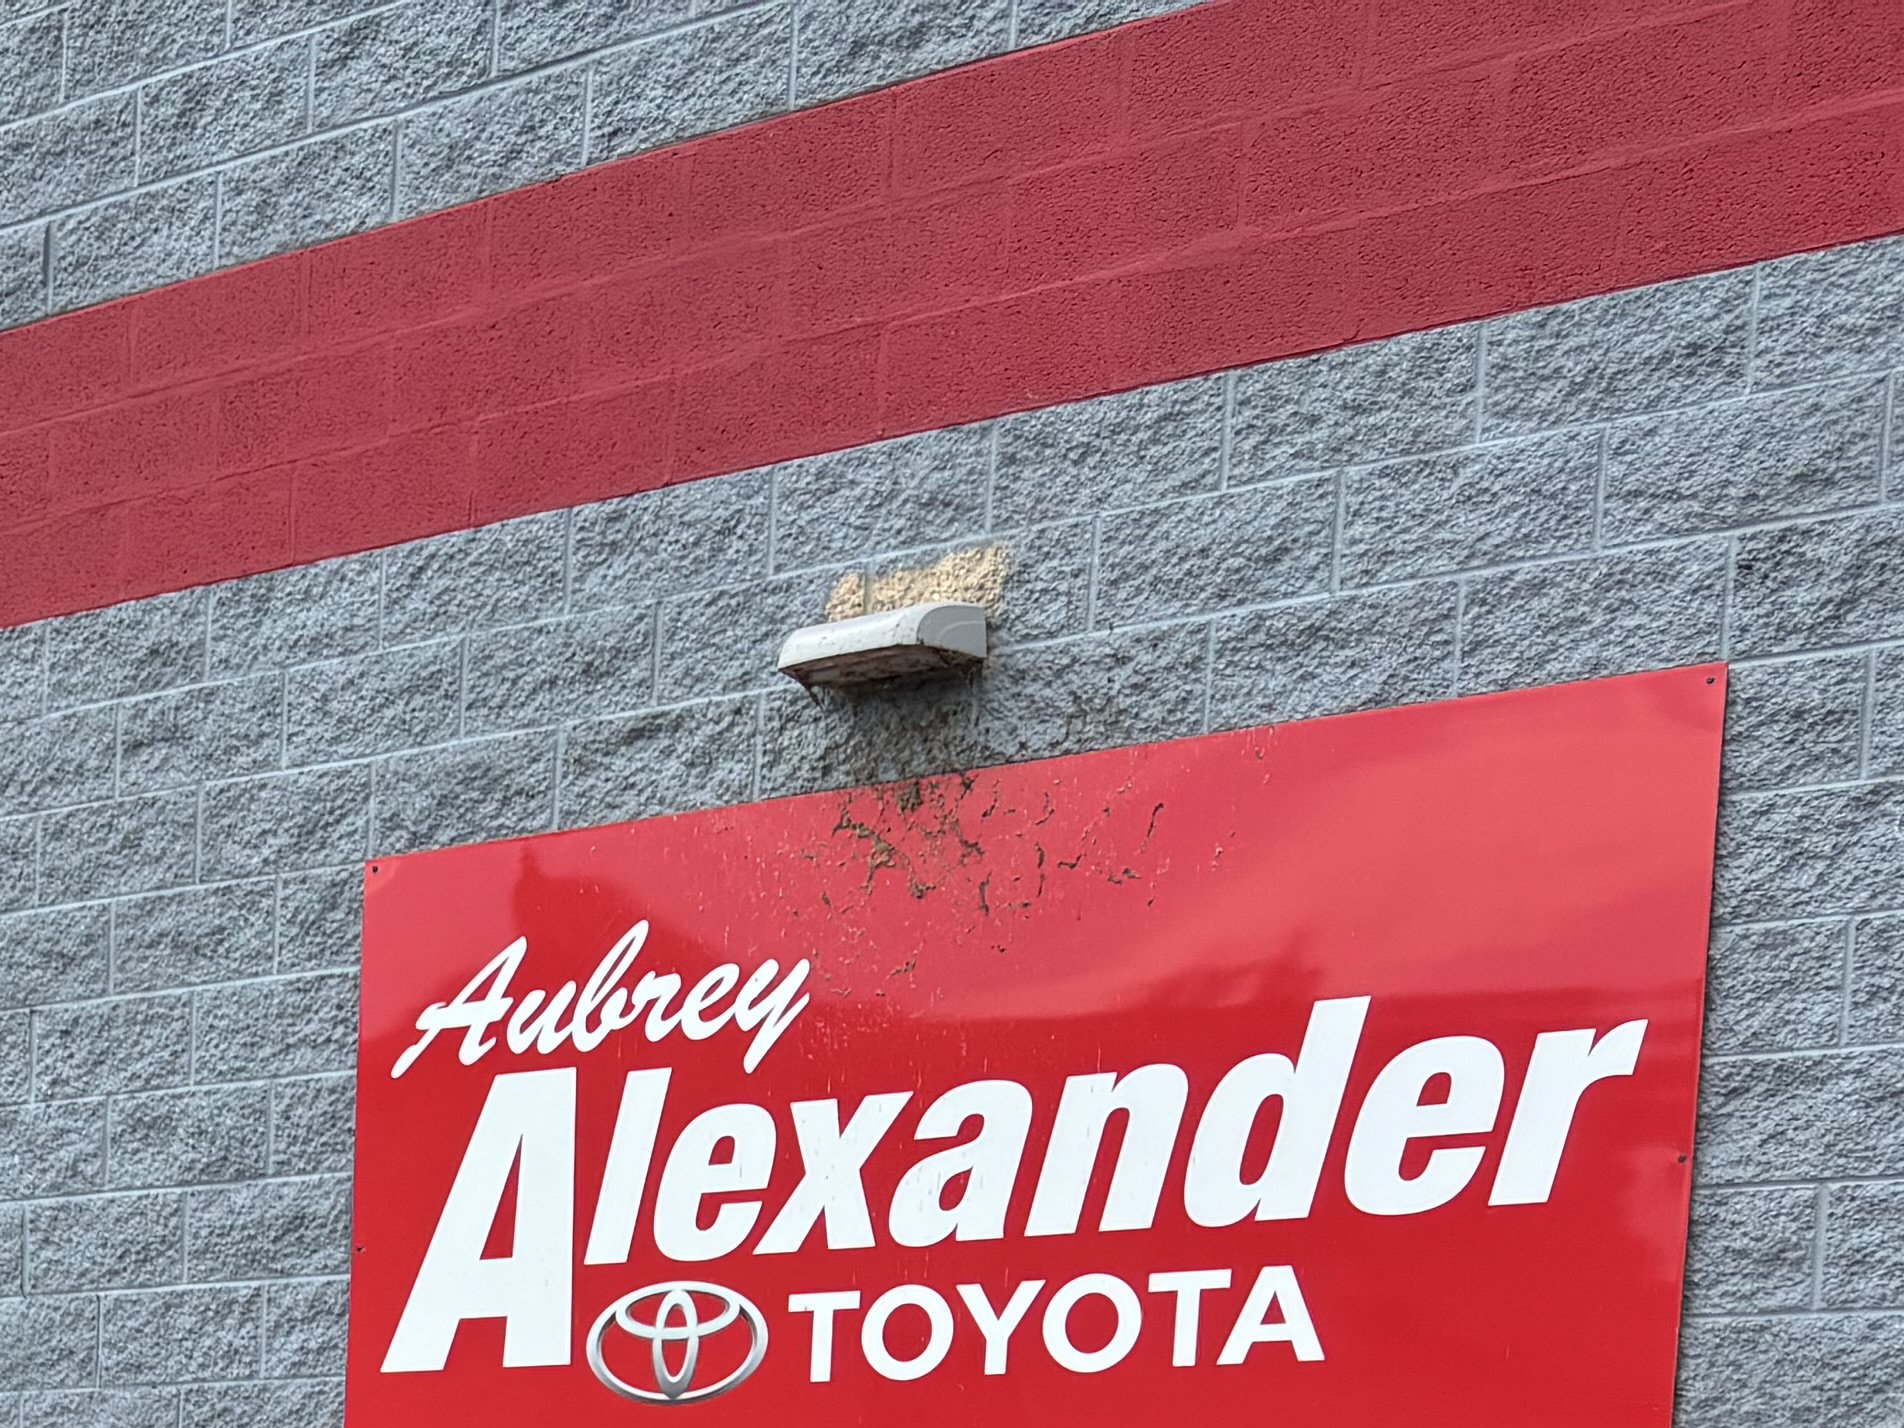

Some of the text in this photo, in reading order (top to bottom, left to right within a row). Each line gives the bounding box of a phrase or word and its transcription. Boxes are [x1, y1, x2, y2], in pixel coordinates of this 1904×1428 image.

[391, 920, 810, 1078] Aubrey
[380, 995, 1649, 1373] Alexander
[787, 1265, 1325, 1383] TOYOTA
